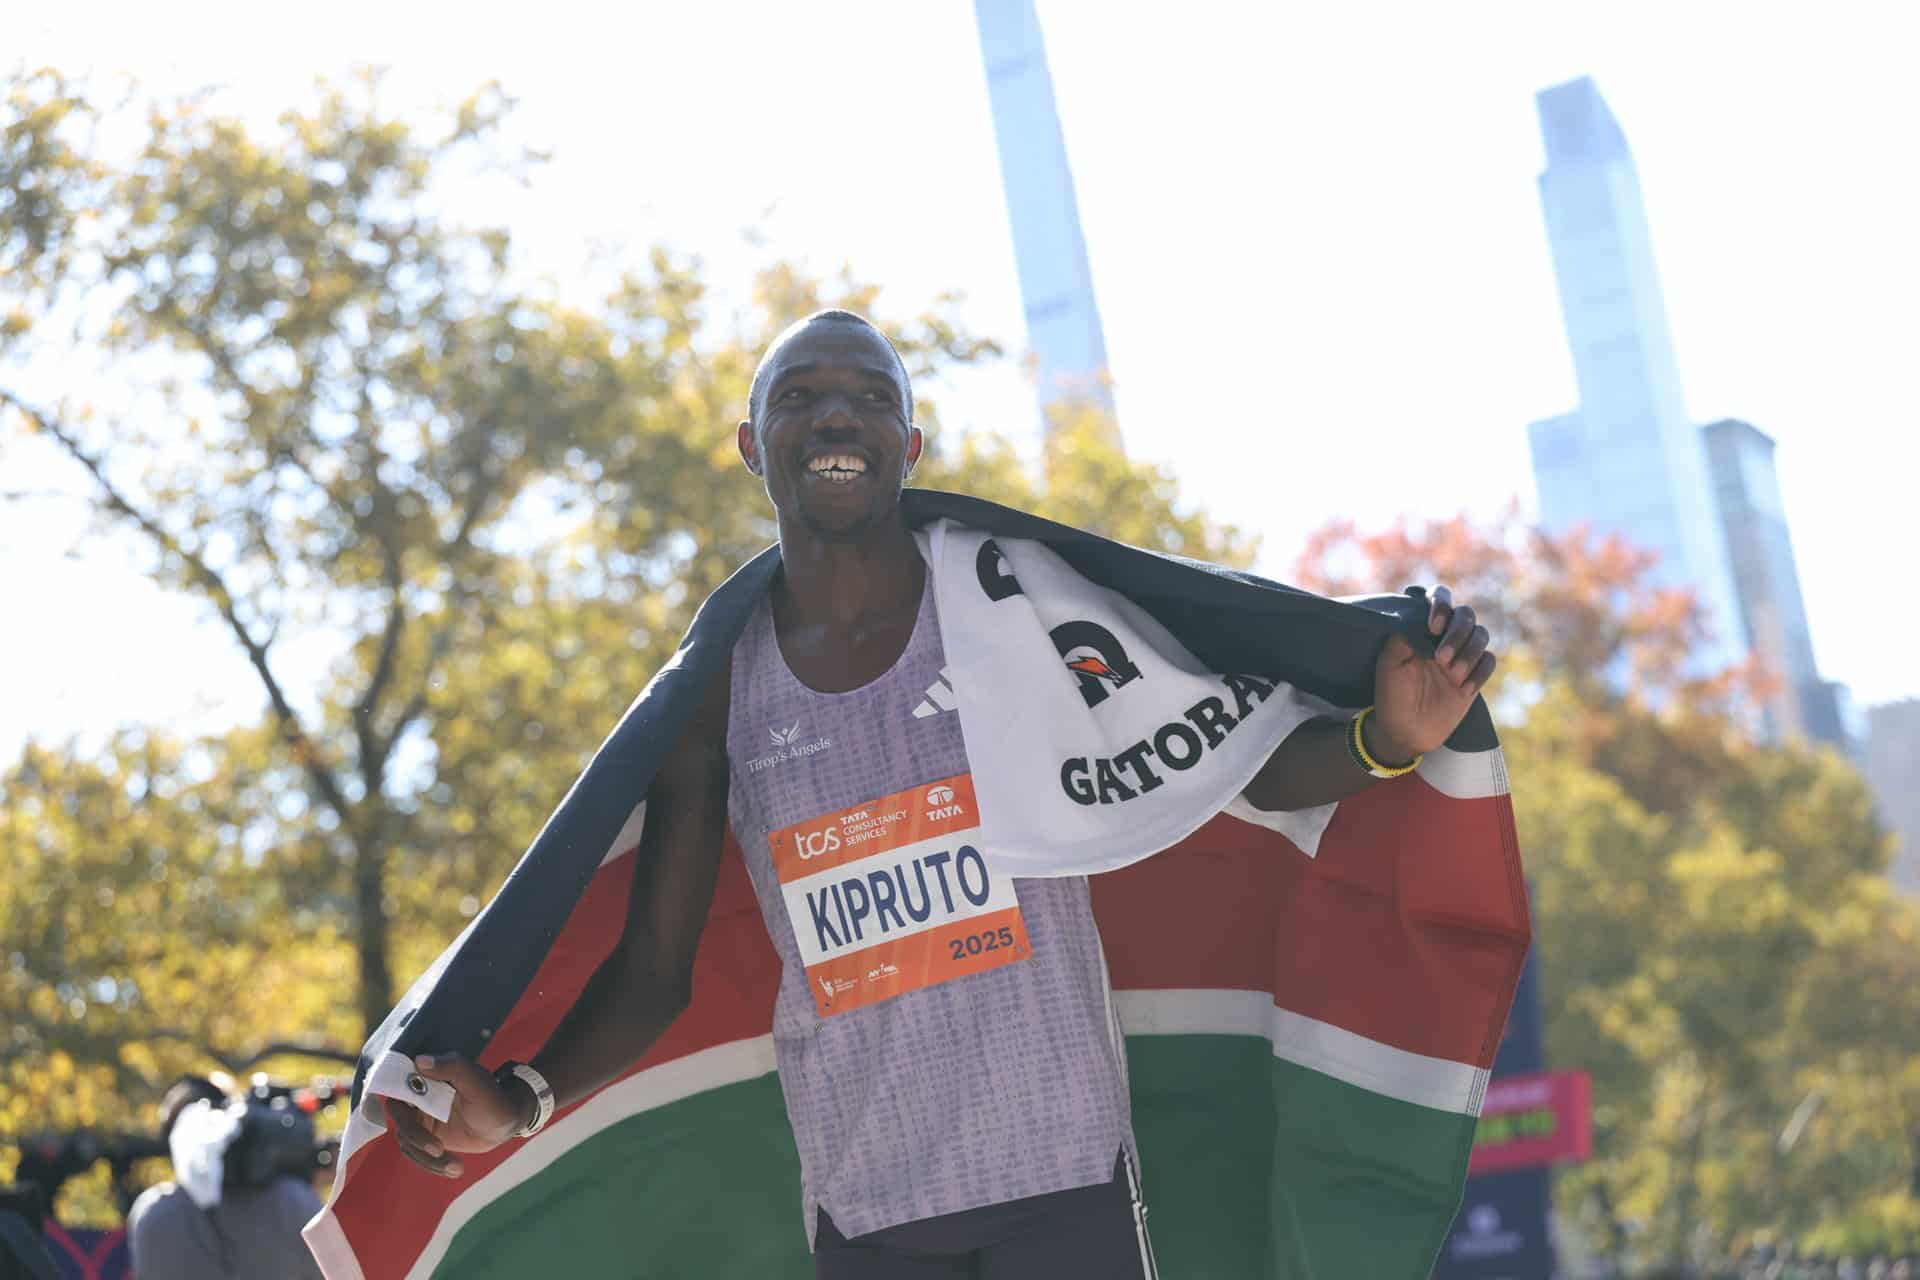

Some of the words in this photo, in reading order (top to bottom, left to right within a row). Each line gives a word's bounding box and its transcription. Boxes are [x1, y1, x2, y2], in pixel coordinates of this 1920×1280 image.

[745, 749, 788, 774] Tirop's
[789, 737, 832, 759] Angels
[840, 810, 869, 826] TATA
[842, 808, 908, 836] CONSULTANCY
[926, 804, 964, 822] TATA
[845, 826, 888, 848] SERVICES
[805, 844, 991, 952] KIPRUTO
[948, 926, 1015, 961] 2025
